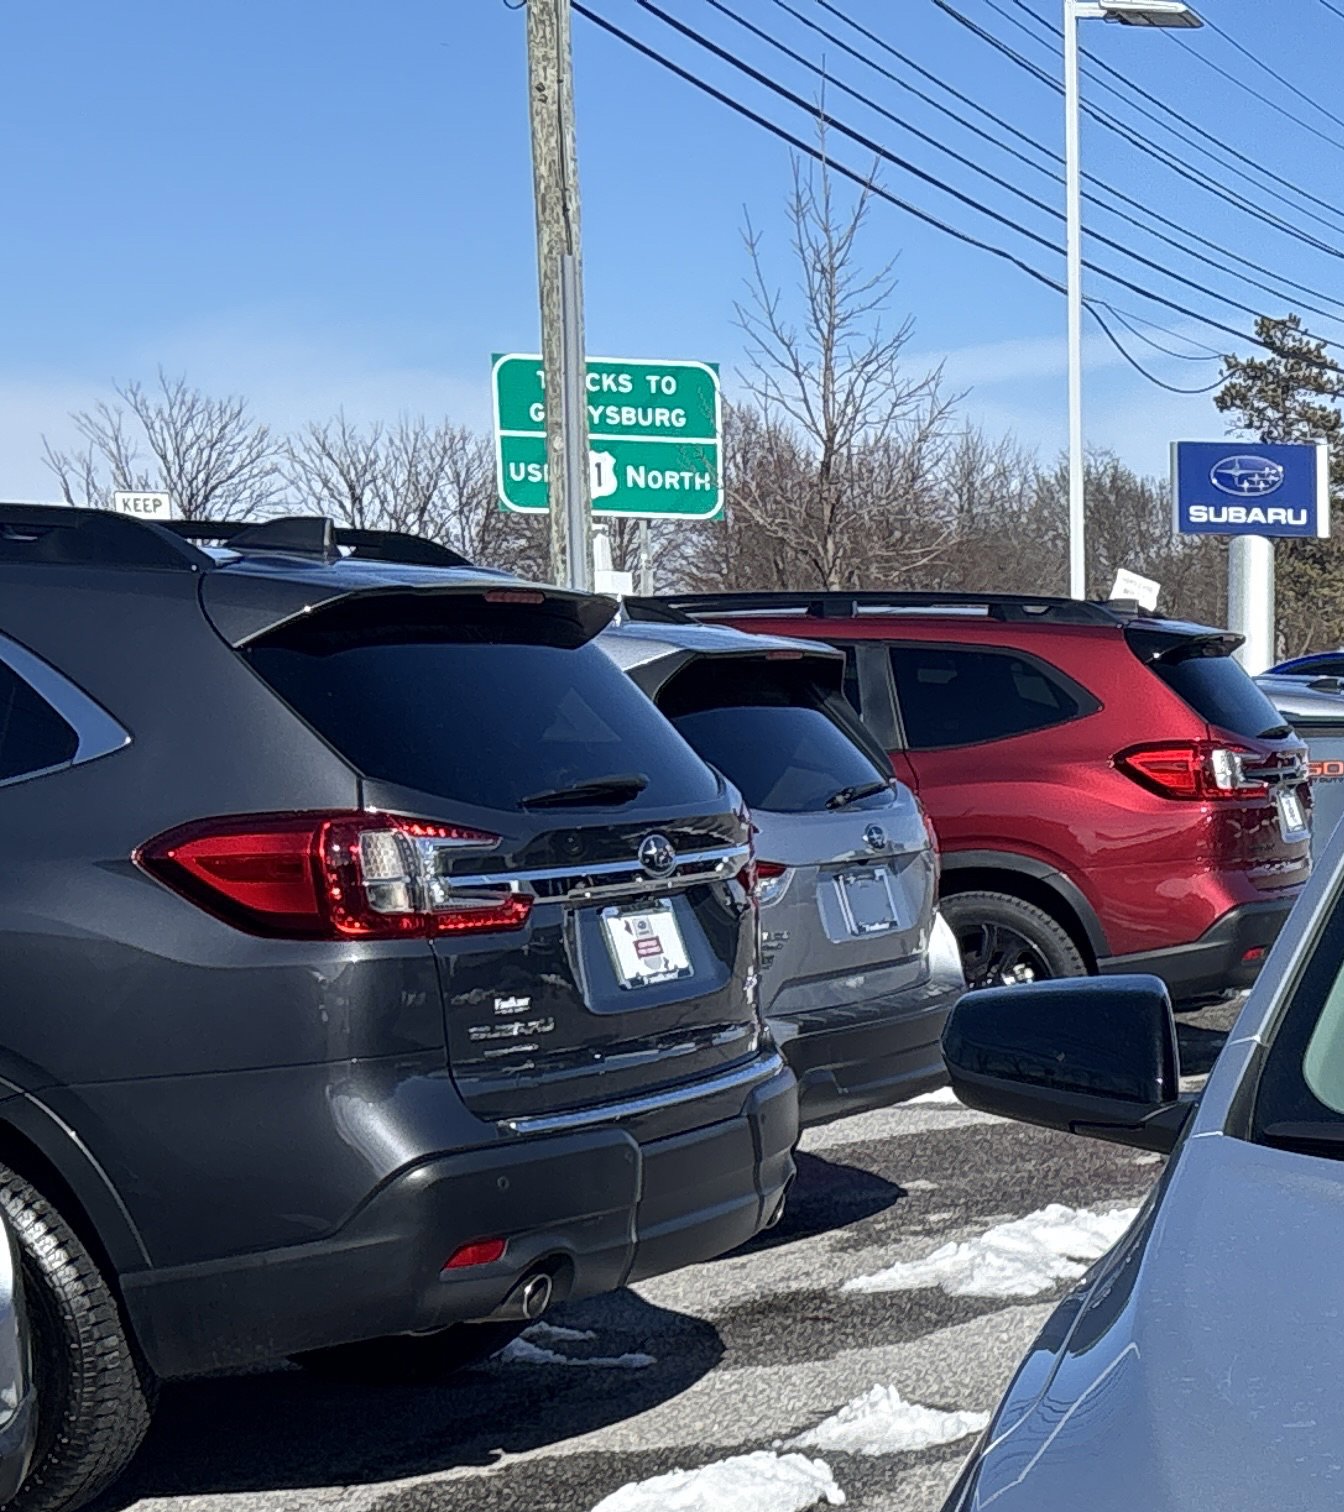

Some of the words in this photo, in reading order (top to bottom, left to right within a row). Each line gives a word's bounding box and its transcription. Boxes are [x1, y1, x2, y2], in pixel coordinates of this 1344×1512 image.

[536, 371, 633, 394] TCKS
[646, 375, 677, 395] TO
[529, 403, 687, 428] GYSBURG
[594, 463, 603, 487] 1
[626, 465, 711, 491] NORTH
[122, 498, 162, 513] KEEP
[1188, 505, 1307, 525] SUBARU
